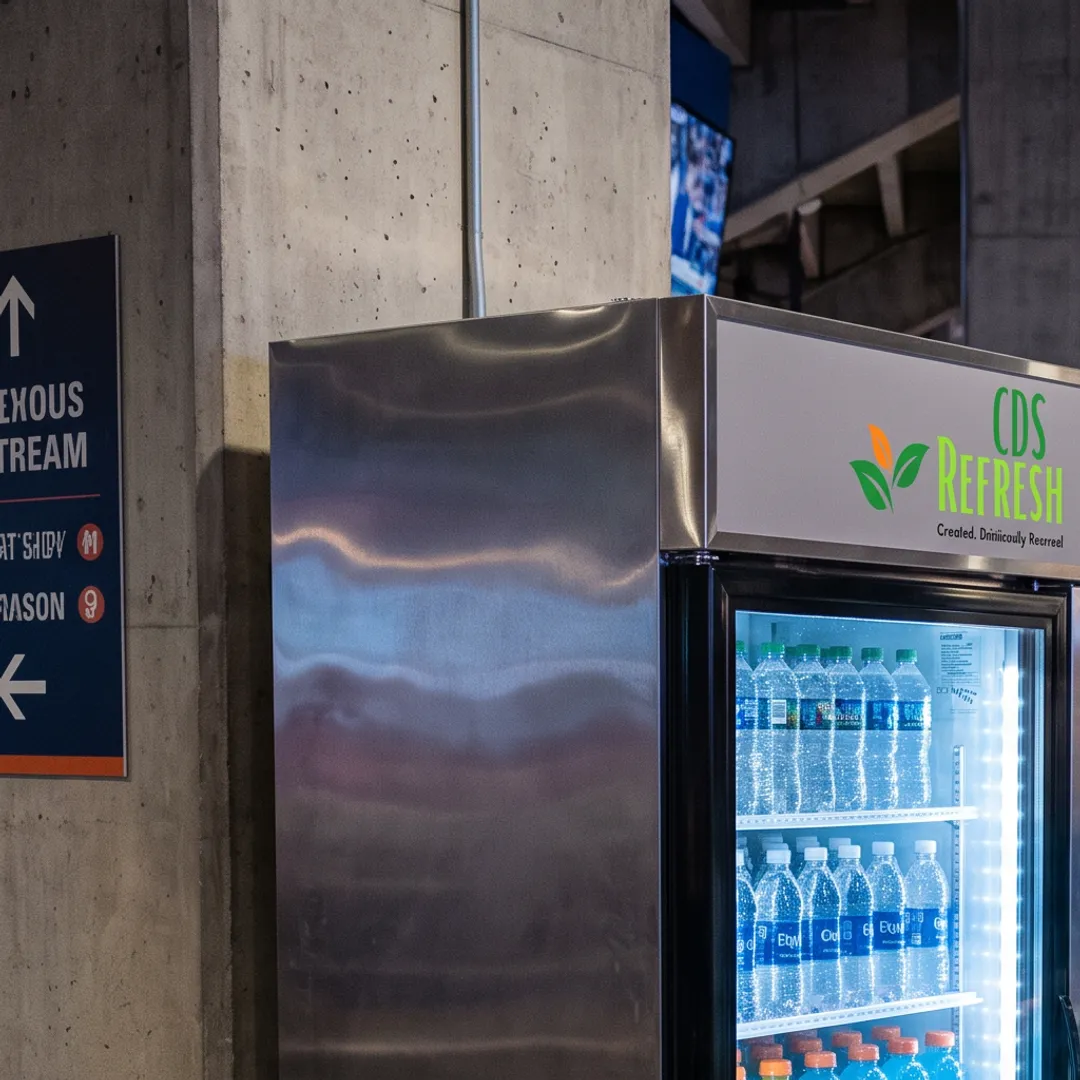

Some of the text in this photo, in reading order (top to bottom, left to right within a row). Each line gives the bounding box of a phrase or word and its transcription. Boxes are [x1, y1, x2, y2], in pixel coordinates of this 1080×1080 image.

[0, 432, 87, 473] TREAM
[993, 387, 1046, 460] CDS
[937, 435, 1063, 524] REFRESH
